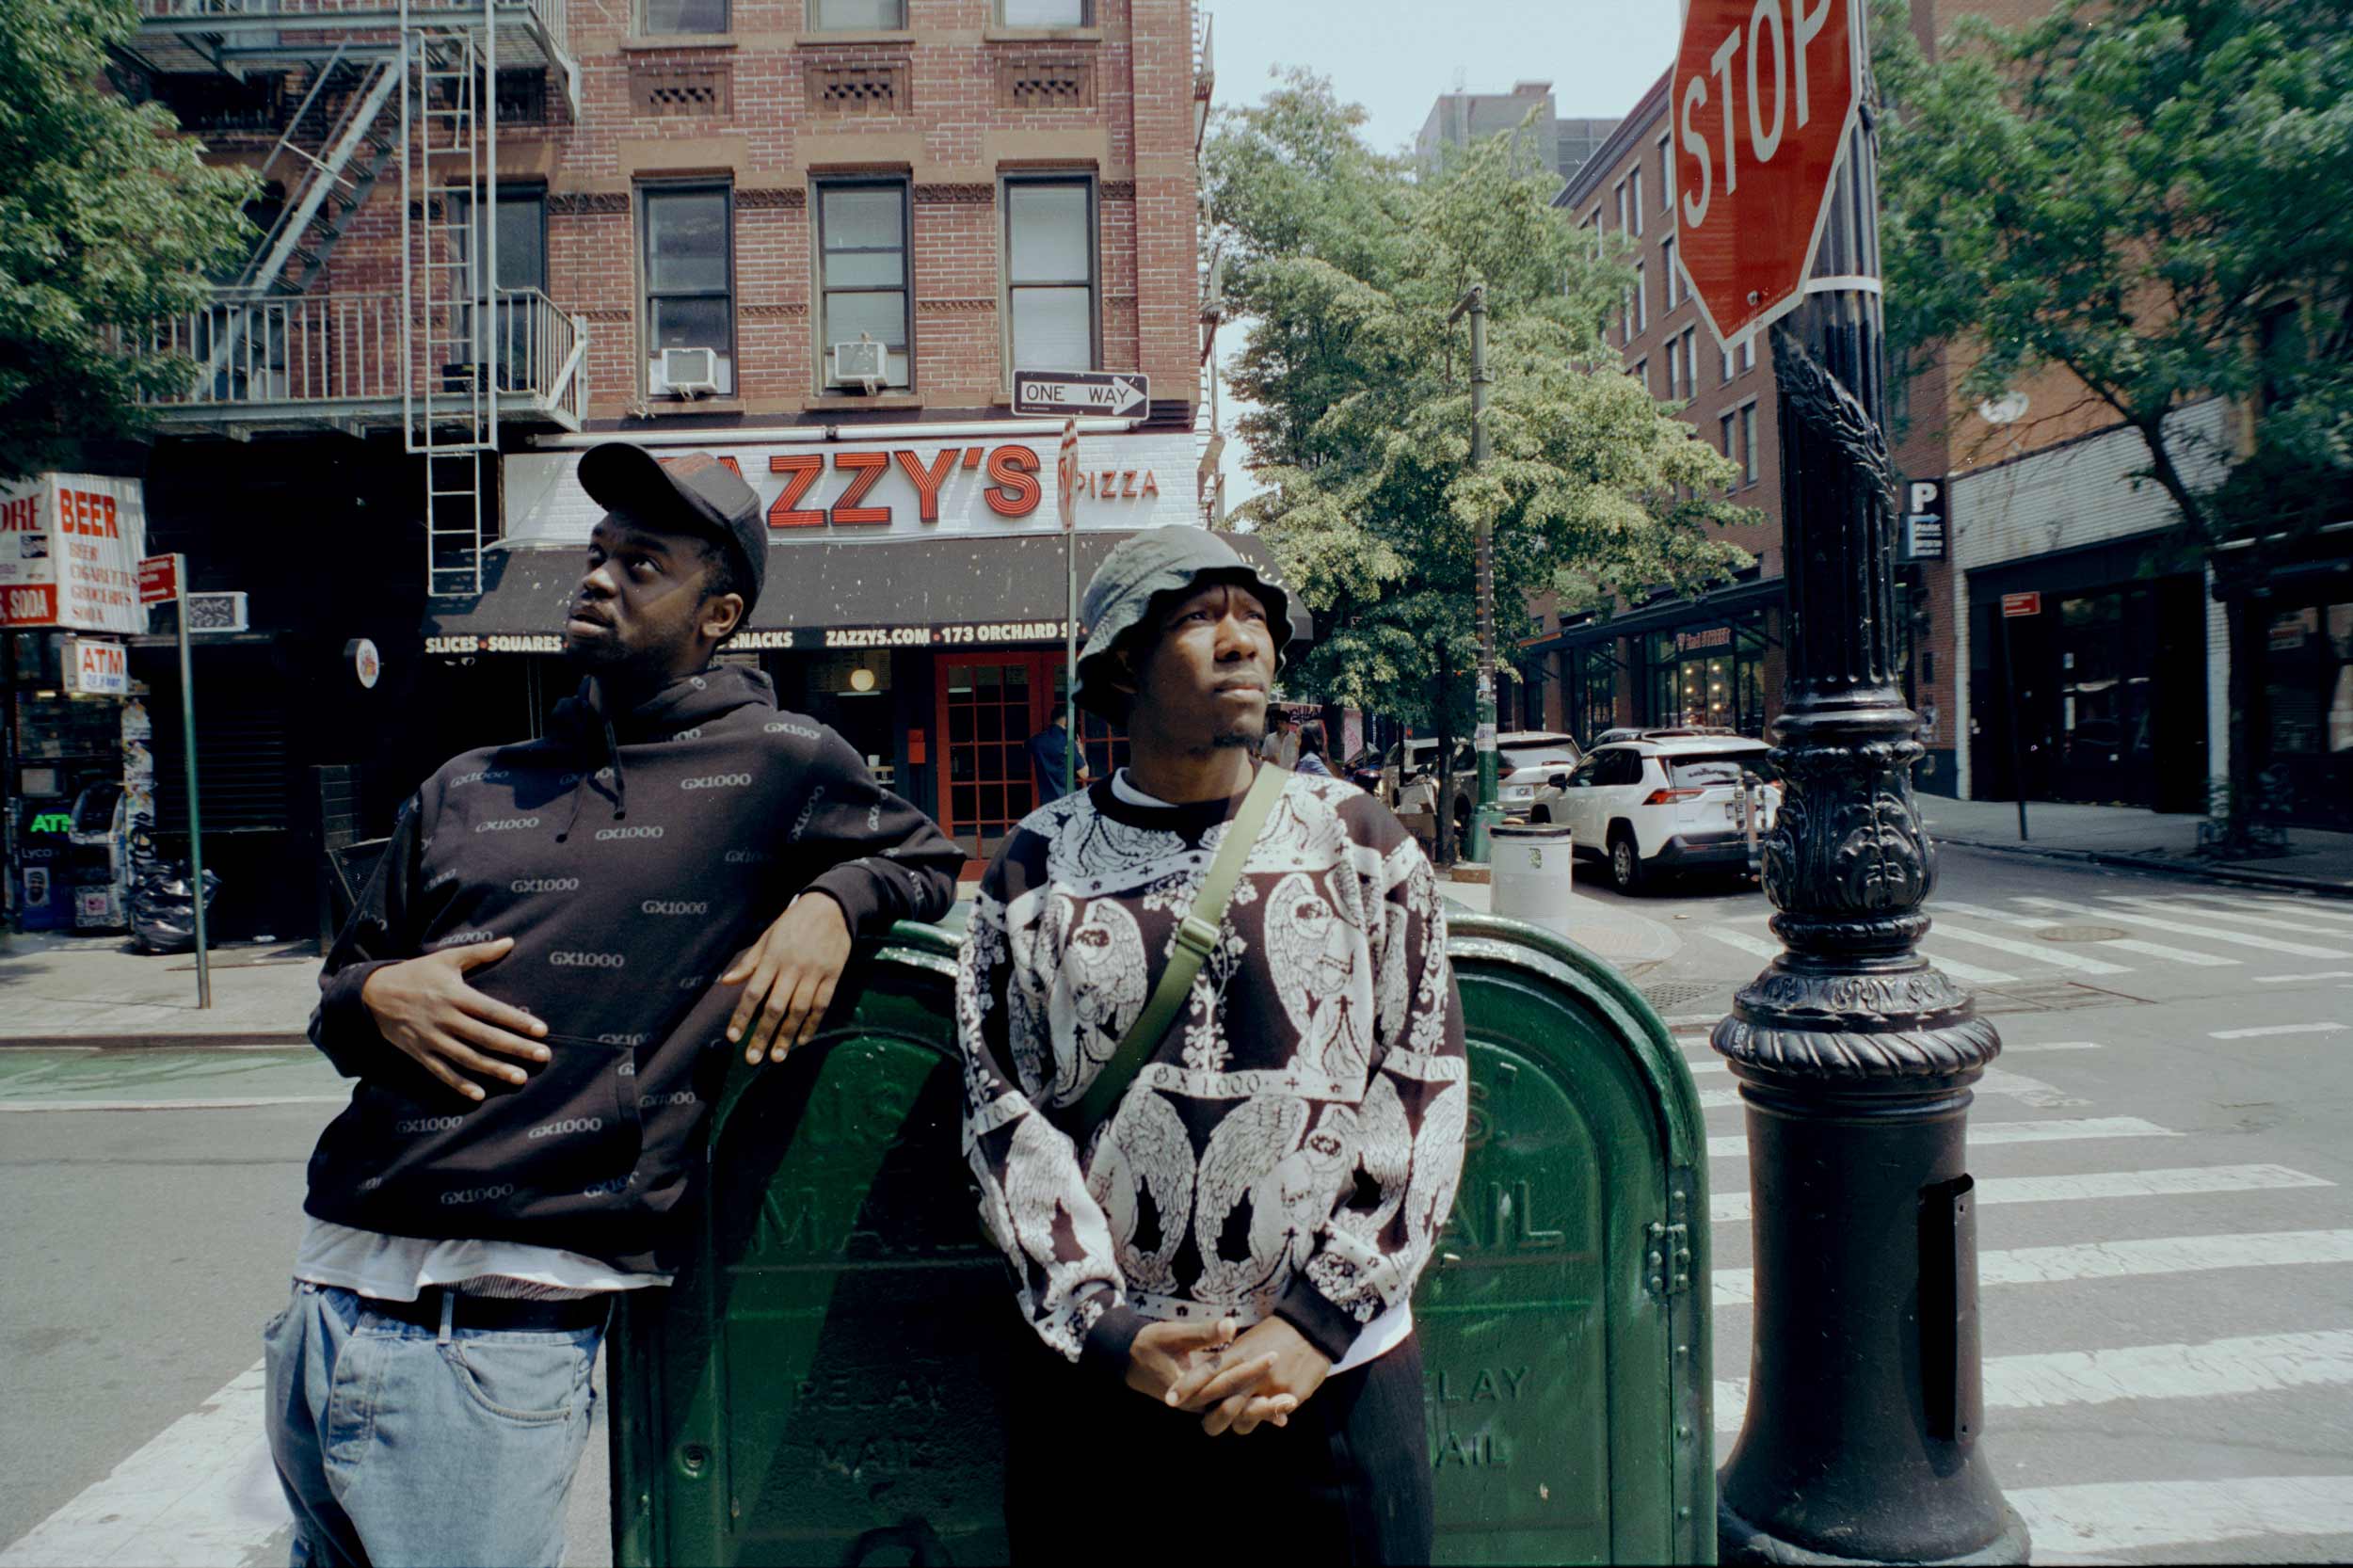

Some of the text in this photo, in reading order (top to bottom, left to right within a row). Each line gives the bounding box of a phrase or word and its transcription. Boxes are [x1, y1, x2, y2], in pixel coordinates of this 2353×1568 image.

[1681, 0, 1832, 229] STOP
[1026, 384, 1129, 404] ONE WAY
[717, 444, 1042, 529] ZZY'S
[1911, 482, 1938, 513] P
[59, 488, 120, 539] BEER
[9, 588, 49, 618] SODA
[425, 636, 478, 653] SLICES
[488, 635, 562, 652] SQUARES
[728, 632, 793, 648] SNACKS
[826, 628, 930, 647] ZAZZYS.COM
[941, 627, 974, 644] 173
[977, 622, 1057, 642] ORCHARD
[83, 647, 123, 677] ATM
[680, 773, 752, 791] GX1000
[474, 816, 539, 833] GX1000
[594, 825, 664, 841] GX1000
[510, 876, 580, 894] GX1000
[641, 899, 708, 916] GX1000
[549, 951, 625, 968] GX1000
[528, 1117, 602, 1140] GX1000
[440, 1183, 515, 1206] GX1000
[1433, 1180, 1566, 1250] AIL
[1423, 1366, 1530, 1405] LAY
[1429, 1430, 1510, 1469] AIL
